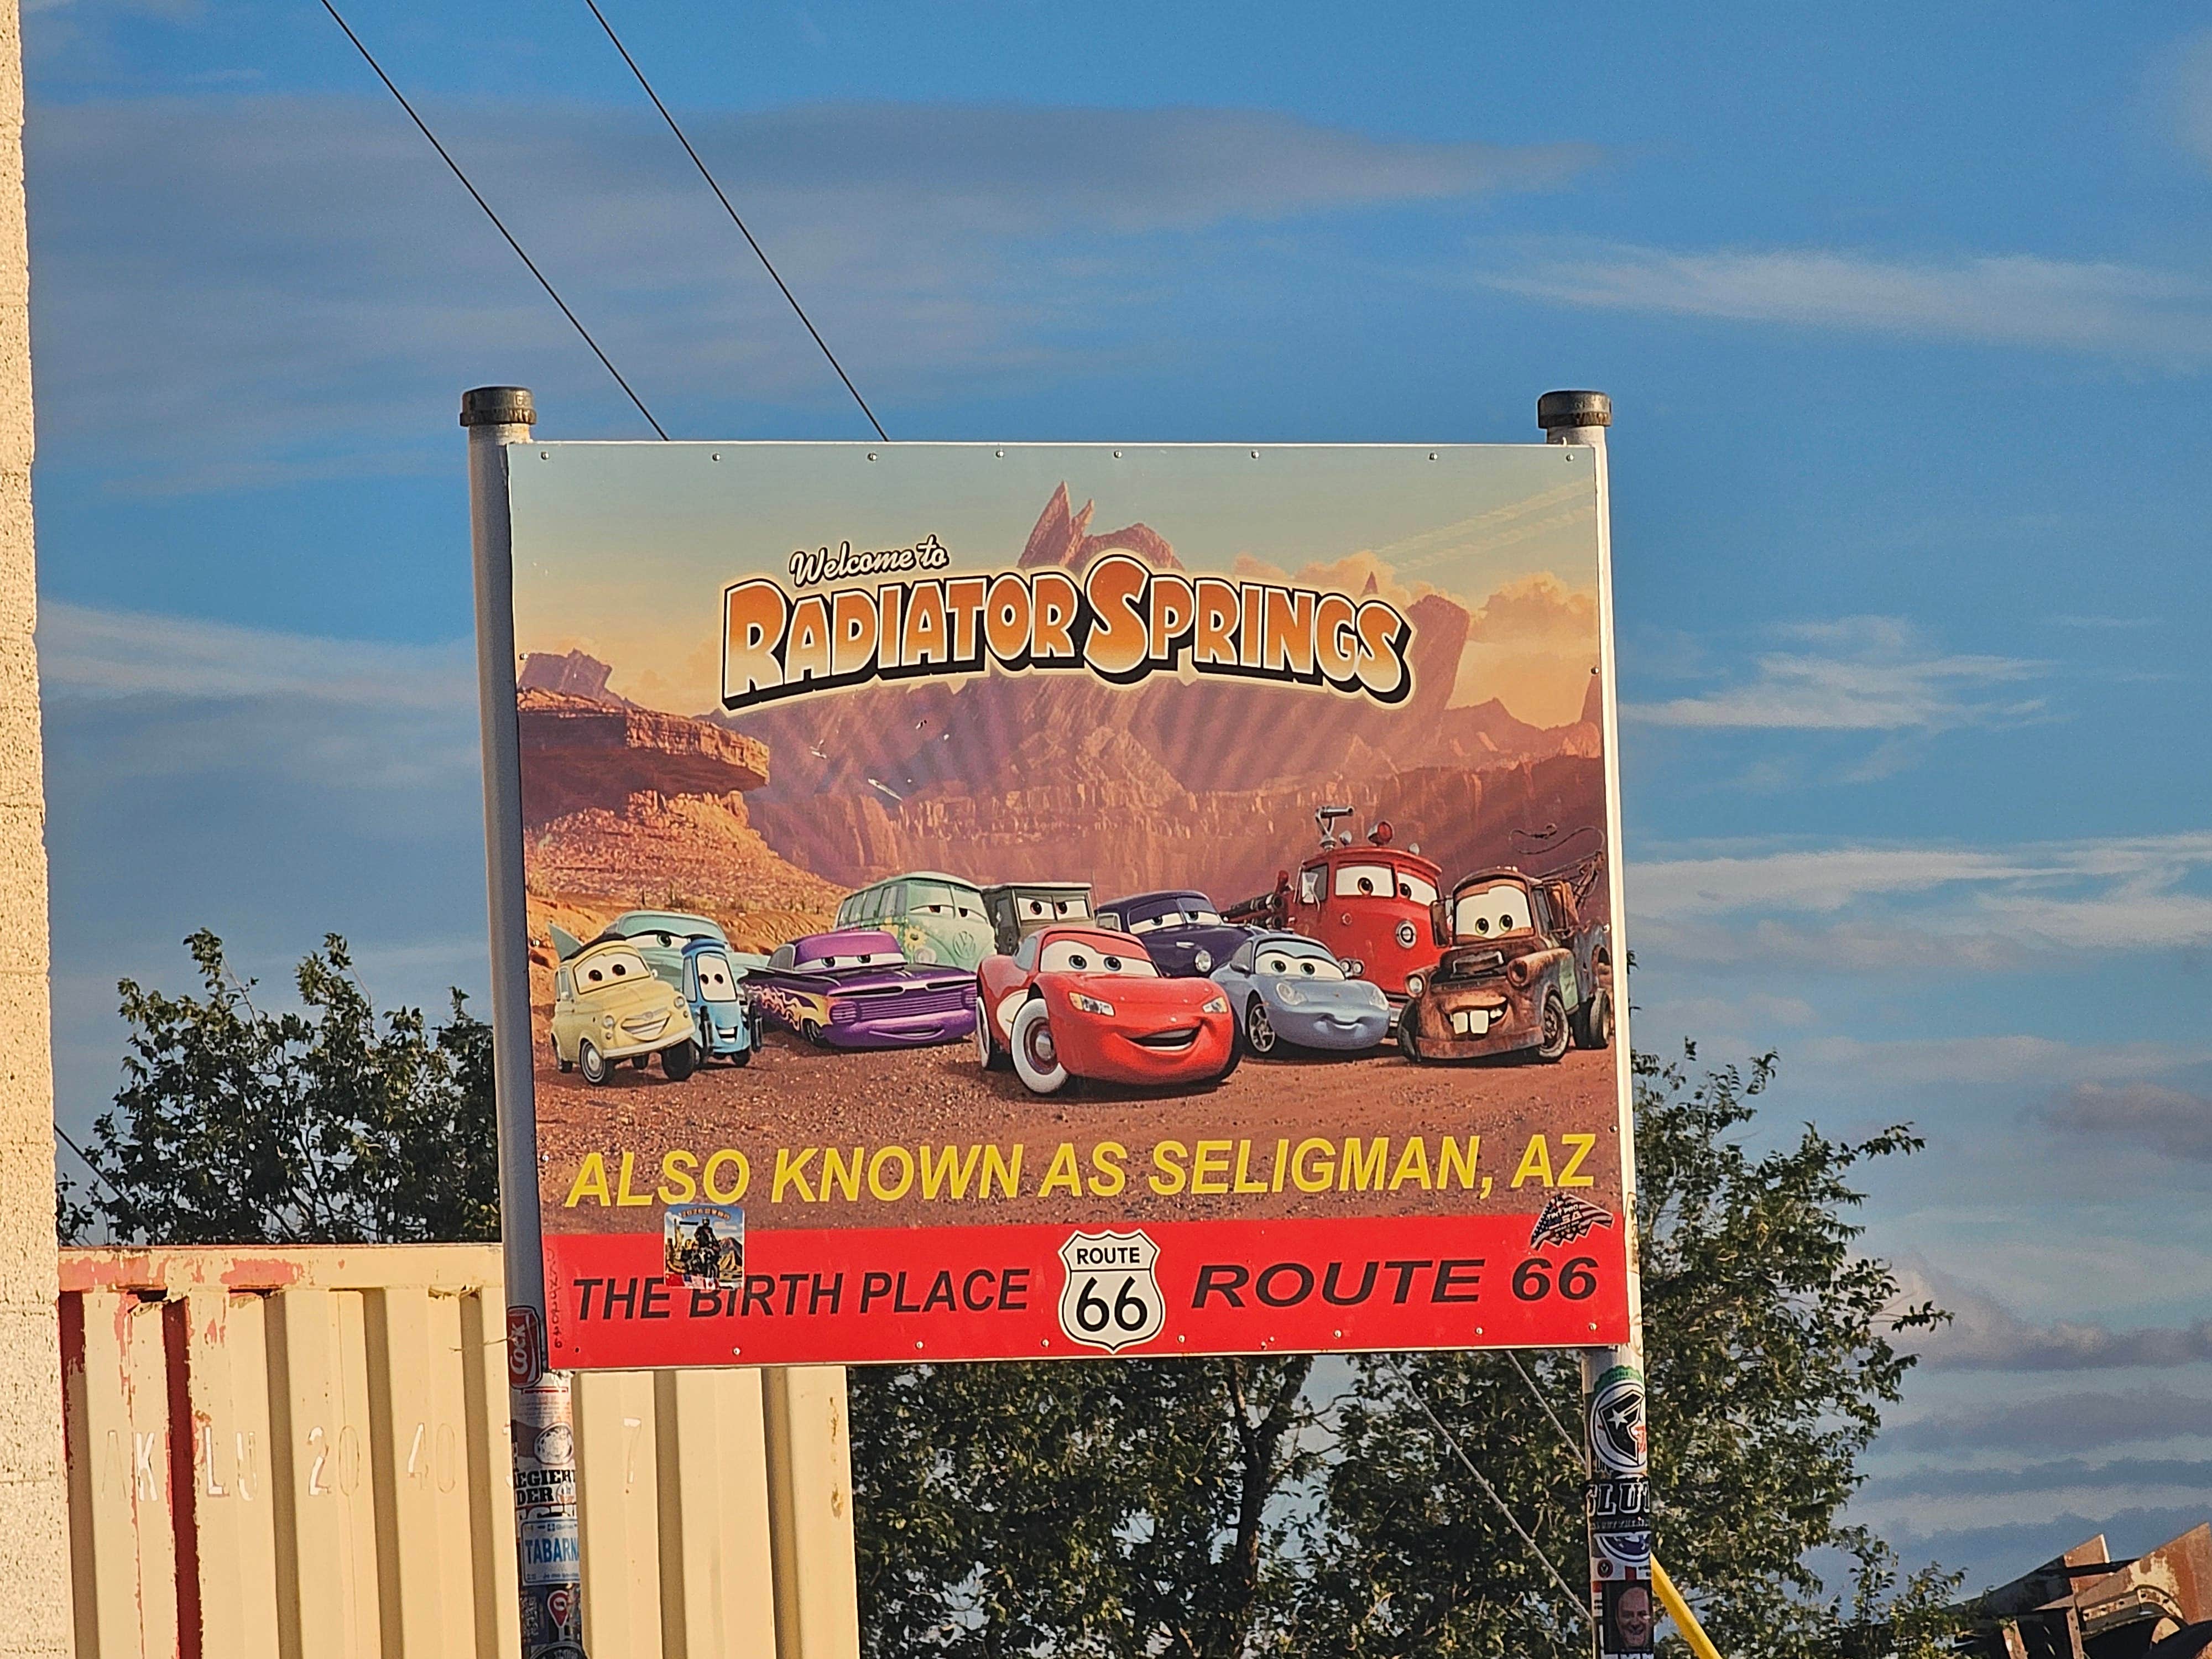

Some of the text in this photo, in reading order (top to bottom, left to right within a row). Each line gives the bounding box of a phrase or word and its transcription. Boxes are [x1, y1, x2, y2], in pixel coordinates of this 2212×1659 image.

[789, 534, 950, 587] Welcome to
[722, 554, 1412, 709] RADIATOR SPRINGS
[565, 1133, 1596, 1207] ALSO KNOWN AS SELIGMAN, AZ
[1076, 1247, 1140, 1265] ROUTE
[573, 1277, 671, 1321] THE
[689, 1273, 844, 1318] BIRTH
[859, 1269, 1031, 1313] PLACE
[1076, 1276, 1148, 1332] 66
[1191, 1257, 1599, 1308] ROUTE 66
[516, 1487, 554, 1505] DER
